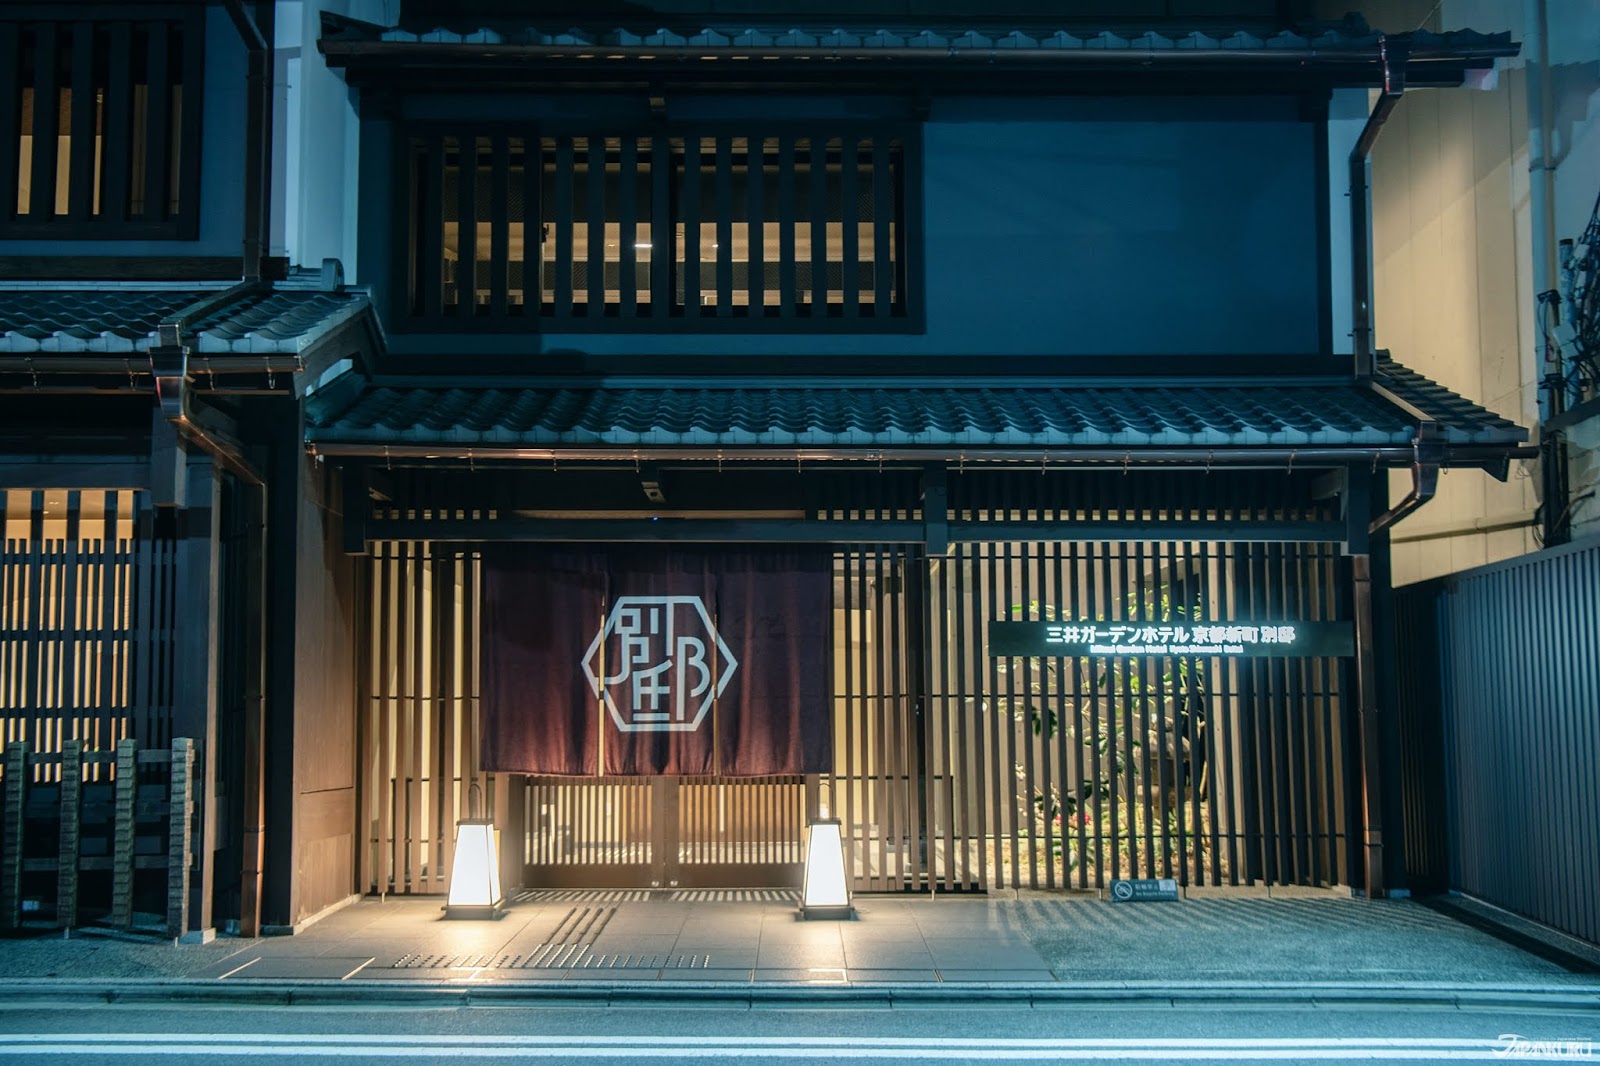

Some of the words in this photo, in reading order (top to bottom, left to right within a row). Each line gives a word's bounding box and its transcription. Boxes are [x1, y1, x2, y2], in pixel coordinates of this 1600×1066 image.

[1046, 626, 1190, 644] 三井ガーデンホテル
